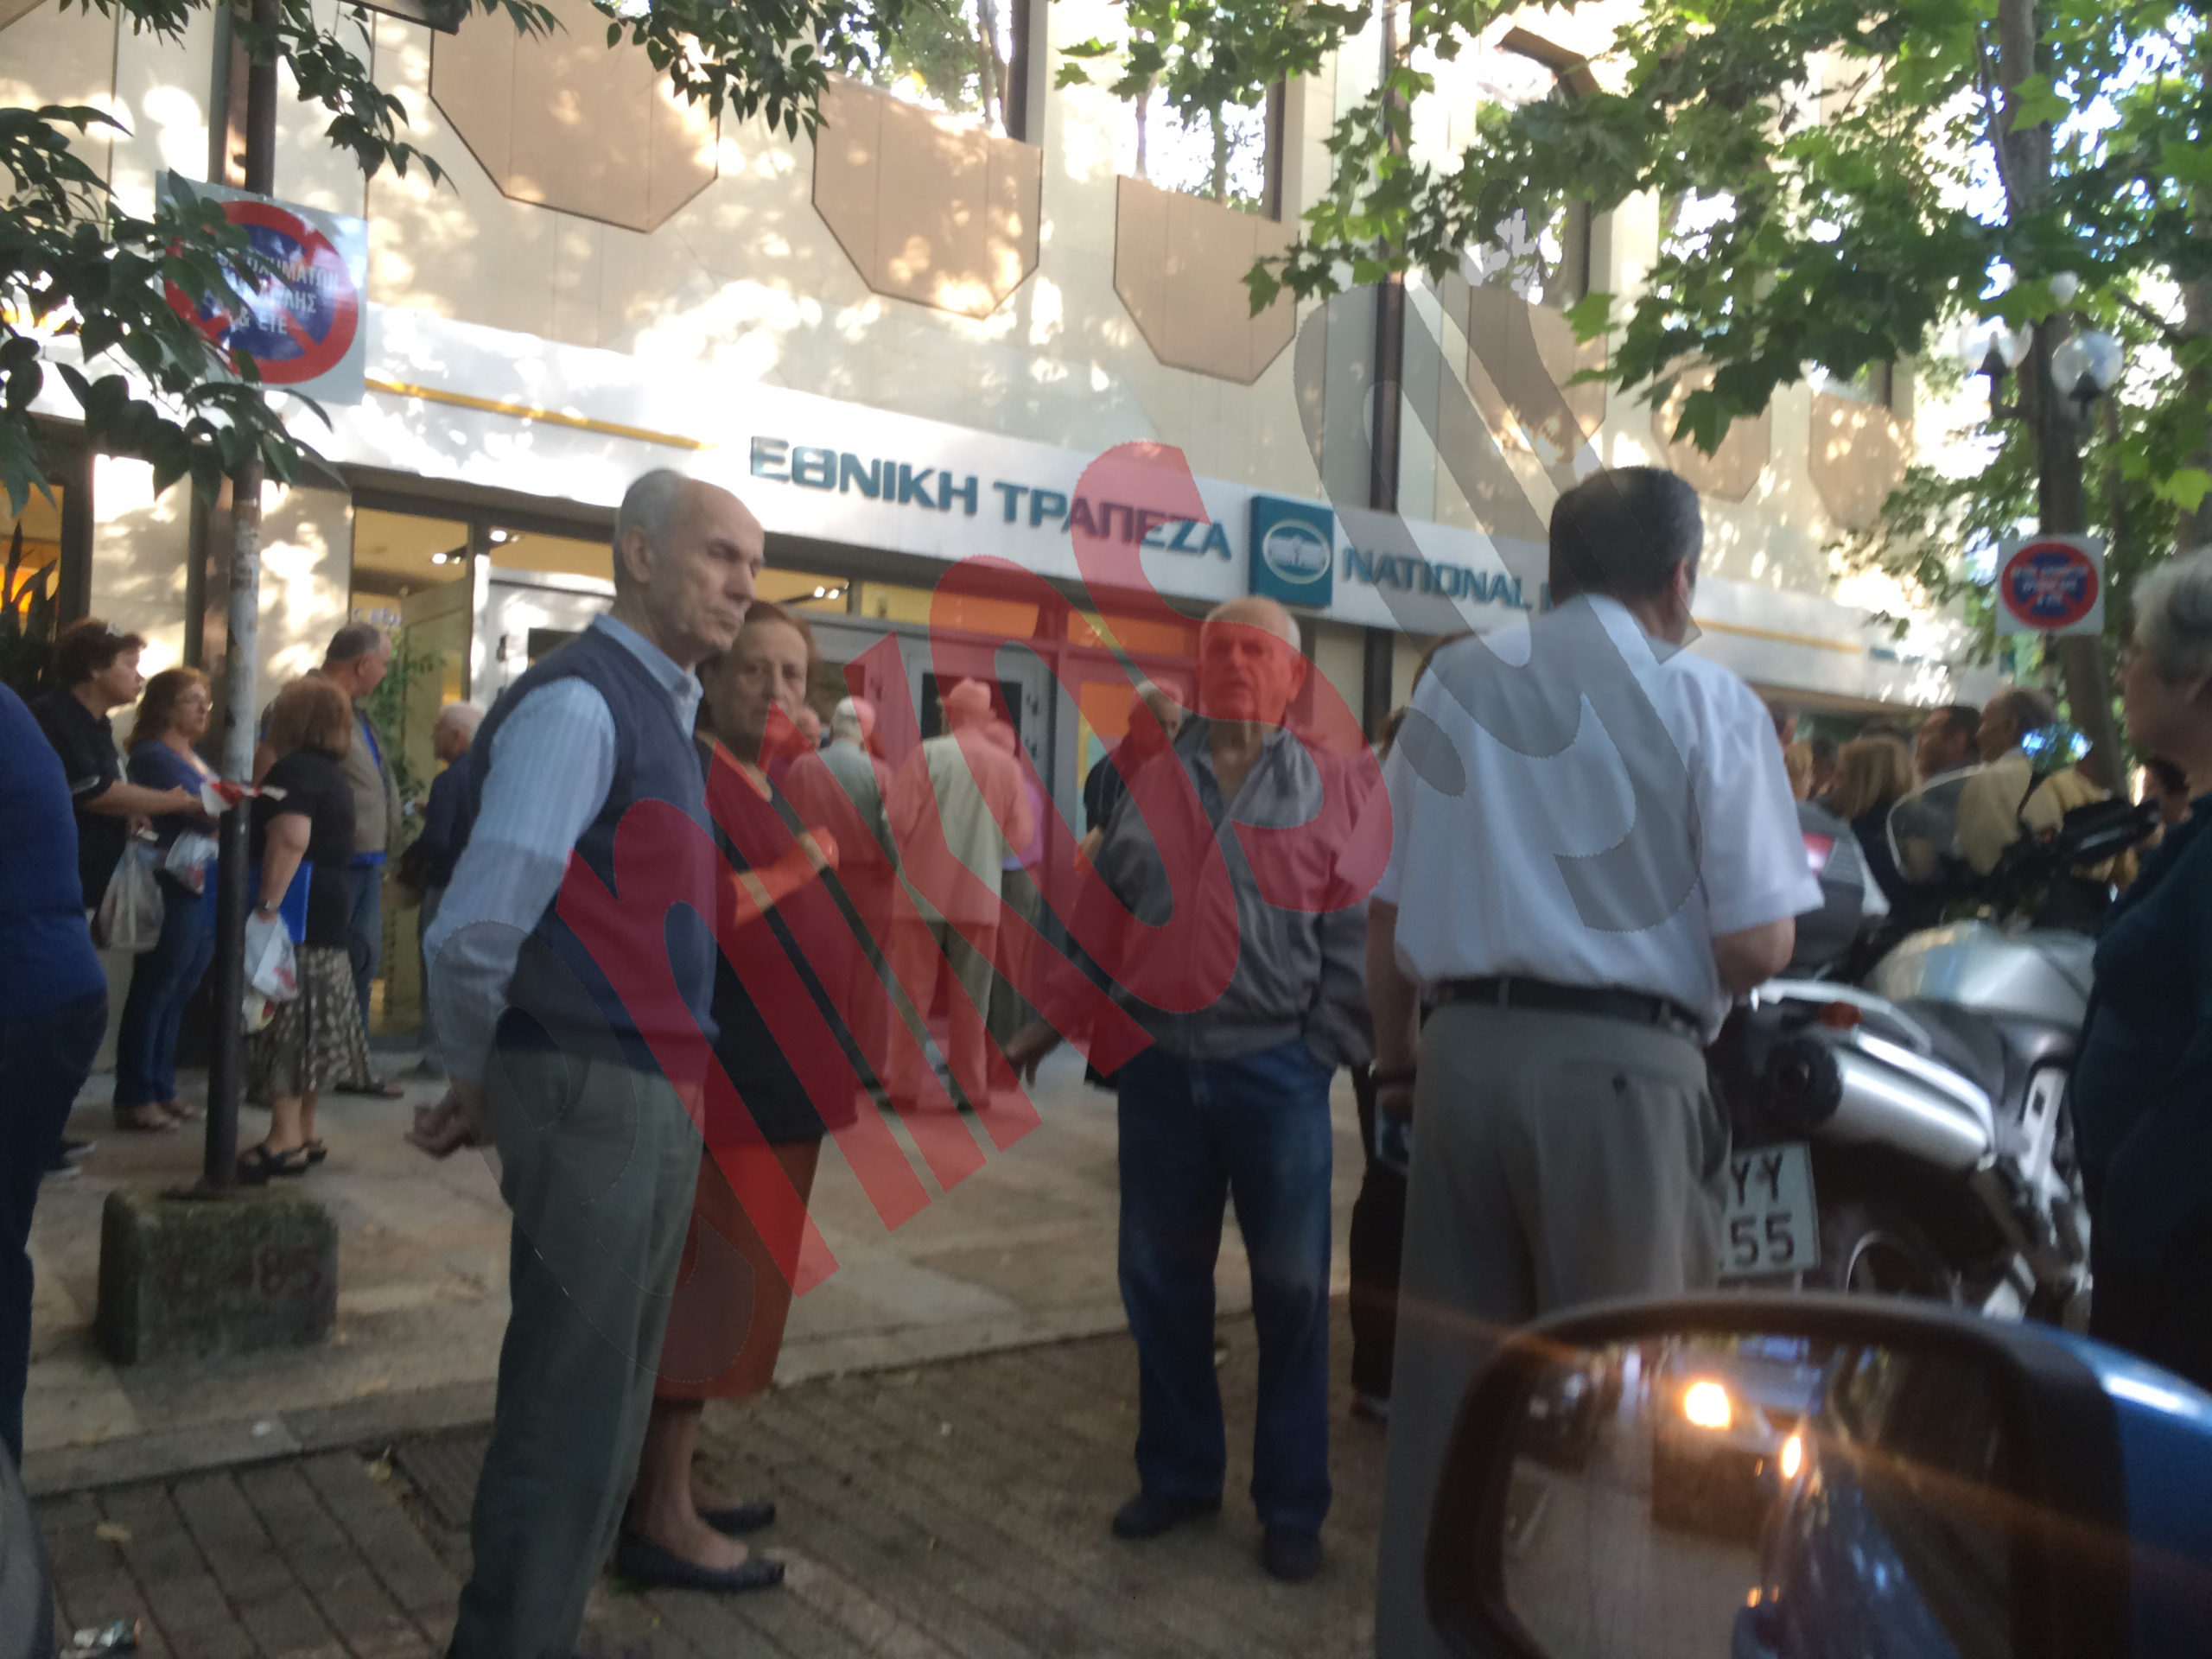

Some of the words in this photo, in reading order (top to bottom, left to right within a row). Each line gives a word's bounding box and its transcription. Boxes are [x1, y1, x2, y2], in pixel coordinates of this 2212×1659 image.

[749, 435, 978, 515] ΕΘΝΙΚΗ
[993, 480, 1233, 560] ΤΡΑΠΕΖΑ
[1343, 547, 1533, 609] NATIONAL
[1719, 1211, 1796, 1268] 55
